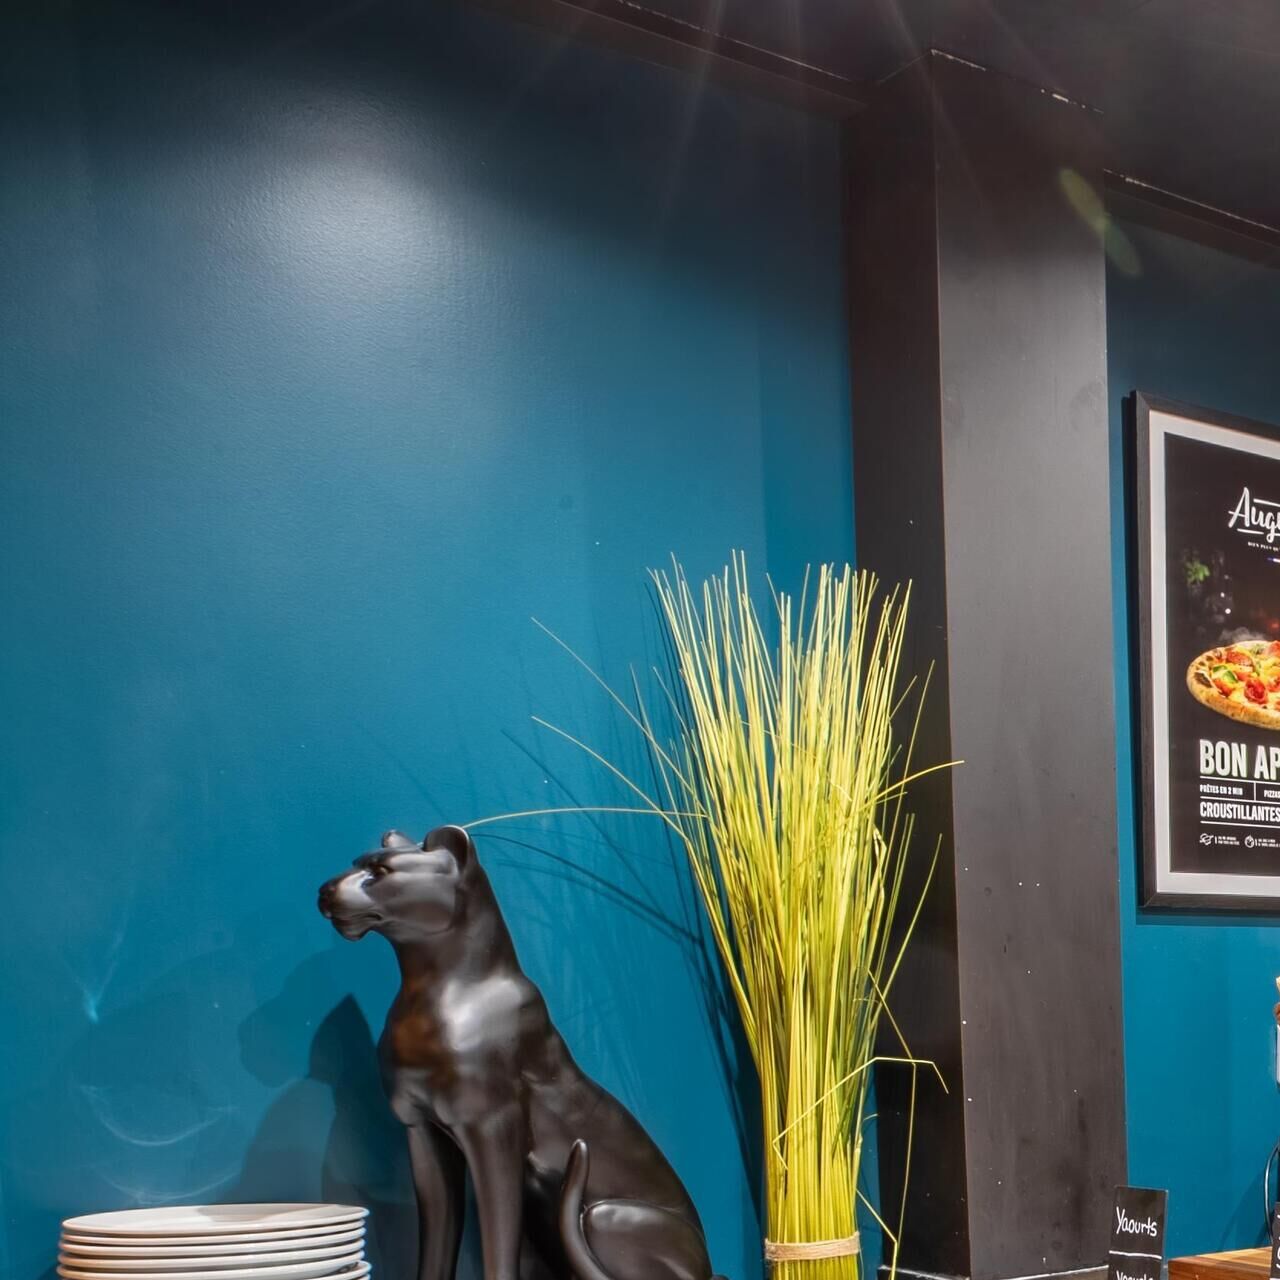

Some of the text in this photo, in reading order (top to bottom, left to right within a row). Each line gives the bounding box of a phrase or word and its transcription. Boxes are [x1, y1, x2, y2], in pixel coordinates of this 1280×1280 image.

[1199, 739, 1248, 778] BON
[1199, 802, 1280, 822] CROUSTILLANTES
[1116, 1206, 1157, 1236] Yaourts
